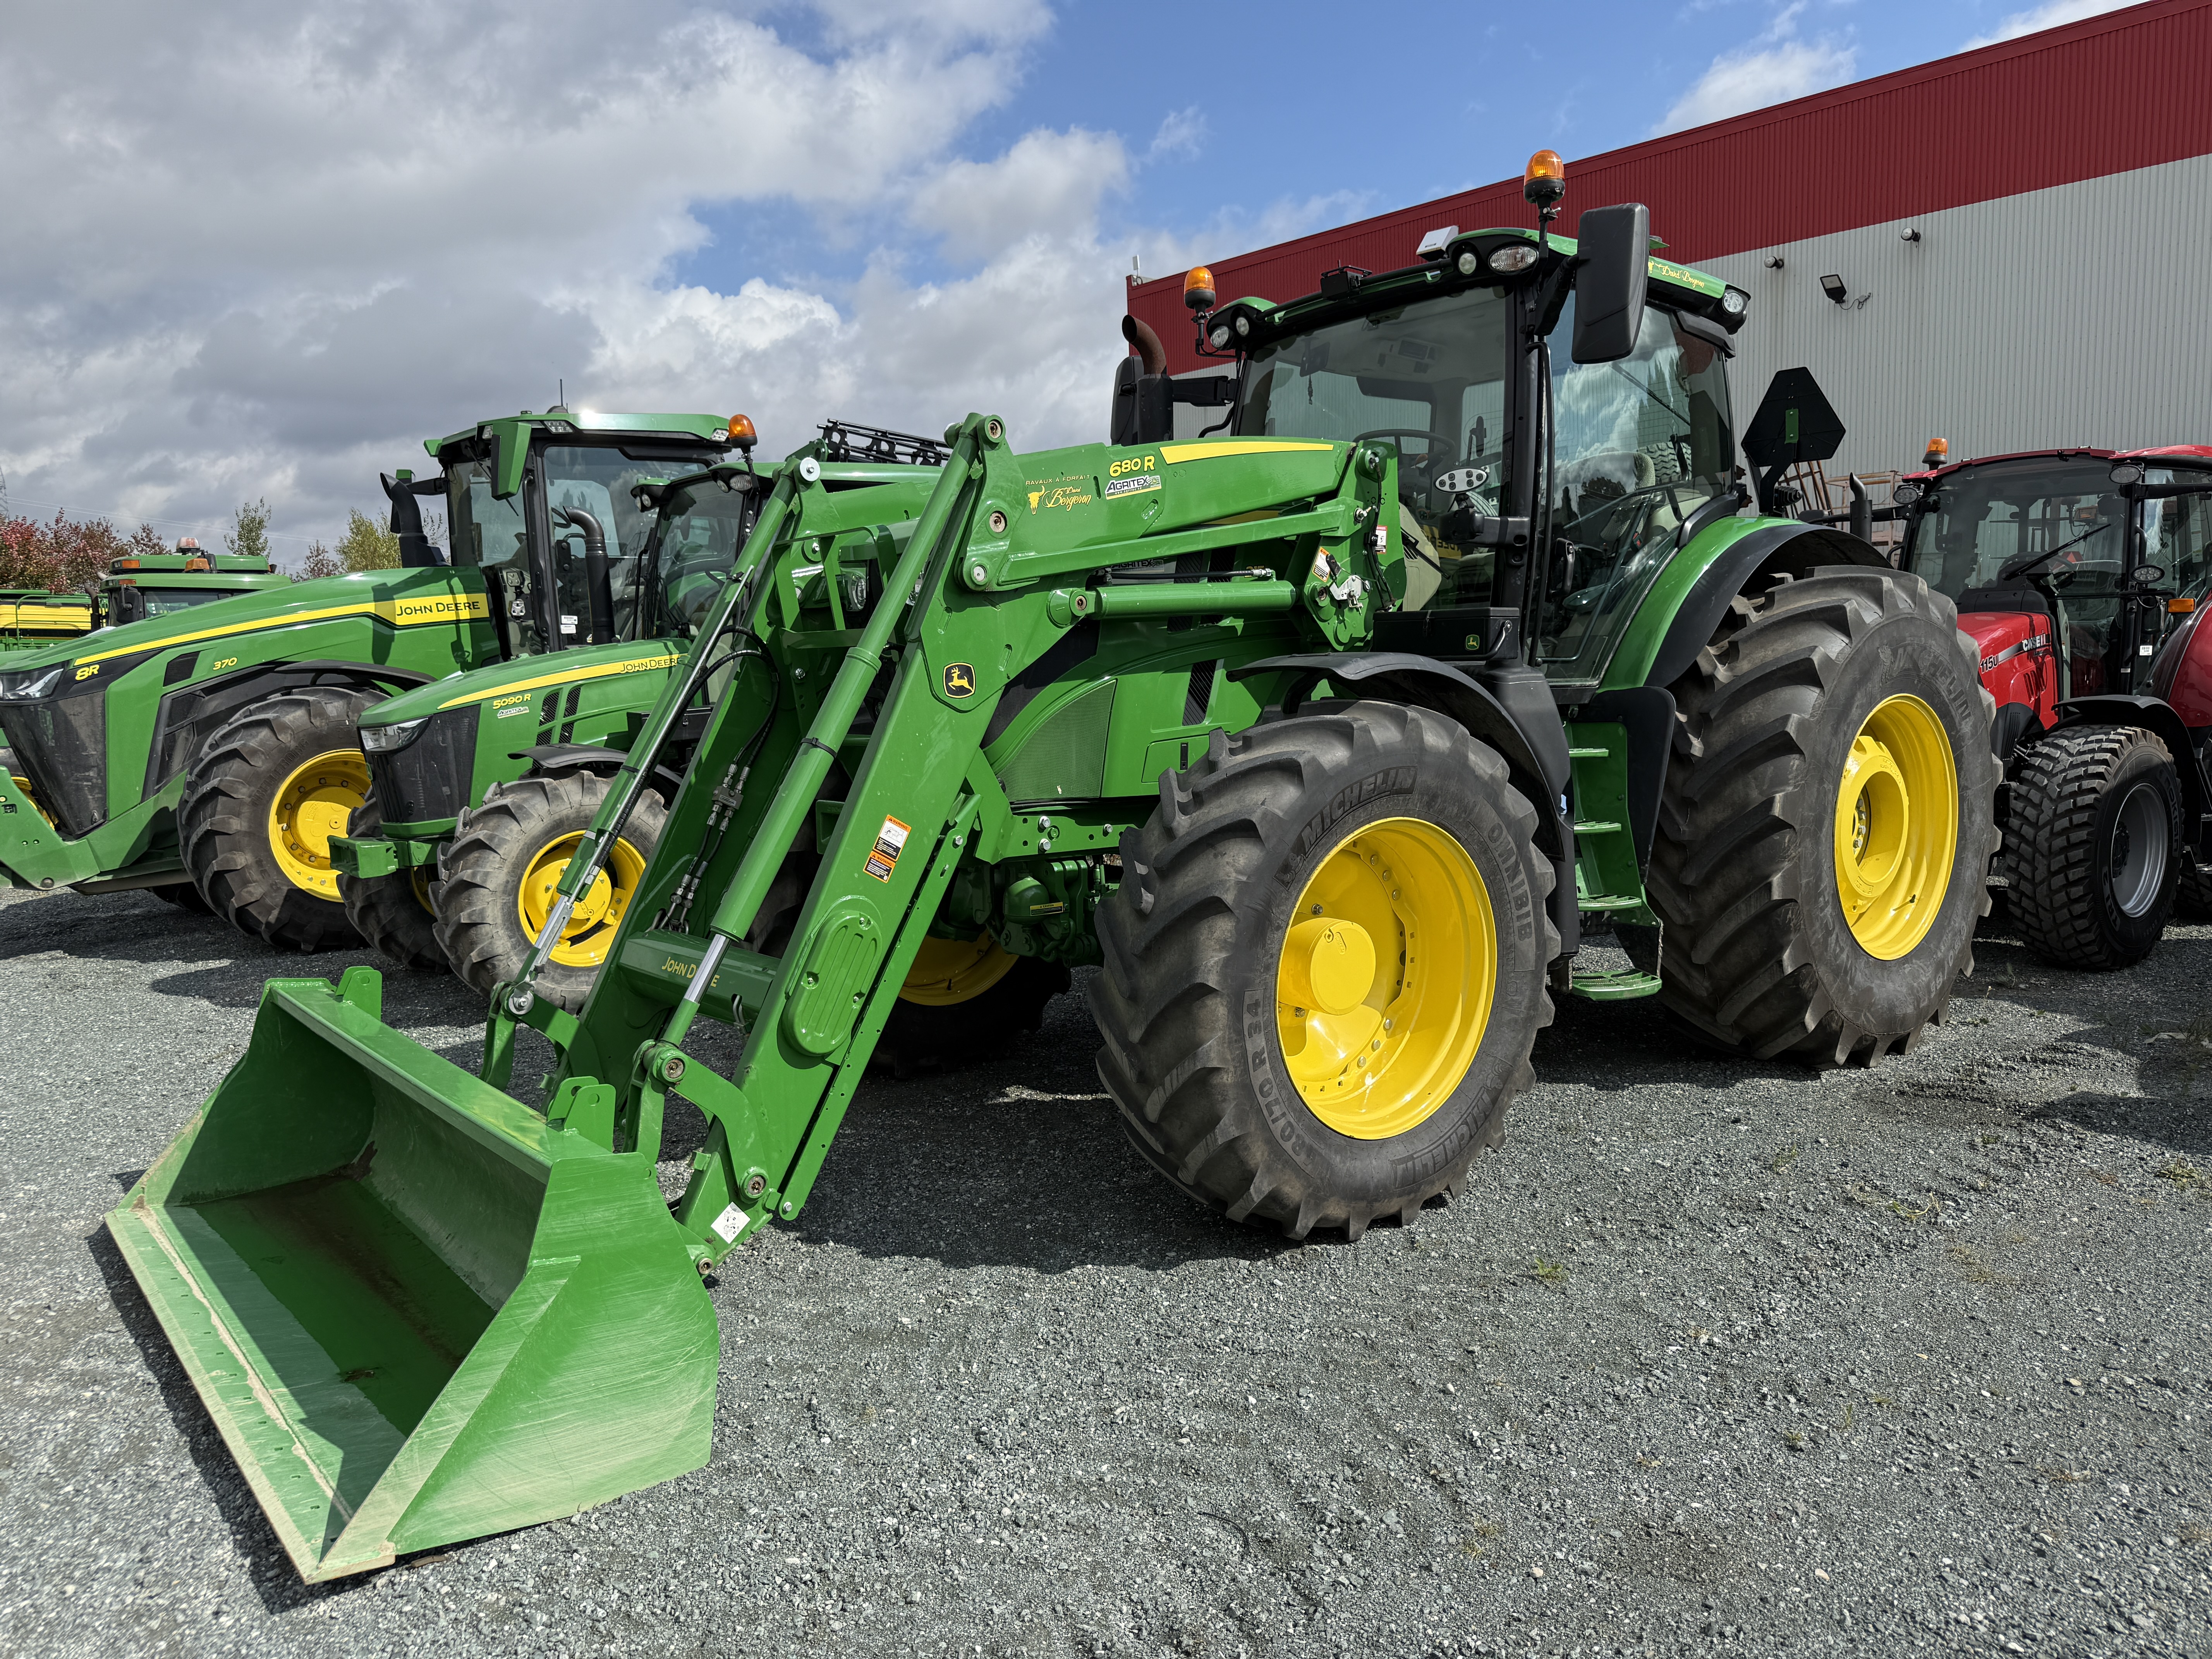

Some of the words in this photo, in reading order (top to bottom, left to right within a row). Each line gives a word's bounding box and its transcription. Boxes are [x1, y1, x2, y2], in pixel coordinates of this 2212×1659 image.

[1109, 458, 1142, 477] 680
[1144, 455, 1155, 472] R
[1106, 476, 1149, 492] AGRITEX
[1041, 488, 1092, 512] Bergeron
[396, 605, 433, 616] JOHN
[435, 601, 481, 613] DEERE
[2023, 636, 2041, 652] CASE
[75, 664, 100, 681] 8R
[213, 657, 238, 671] 370
[620, 663, 648, 672] JOHN
[1980, 654, 1999, 674] 115U
[493, 696, 523, 709] 5090
[1302, 768, 1416, 854] MICHELIN
[1488, 822, 1532, 941] OMNIBIB
[661, 956, 688, 976] JOHN
[1247, 998, 1262, 1039] 34
[1252, 1045, 1266, 1072] R
